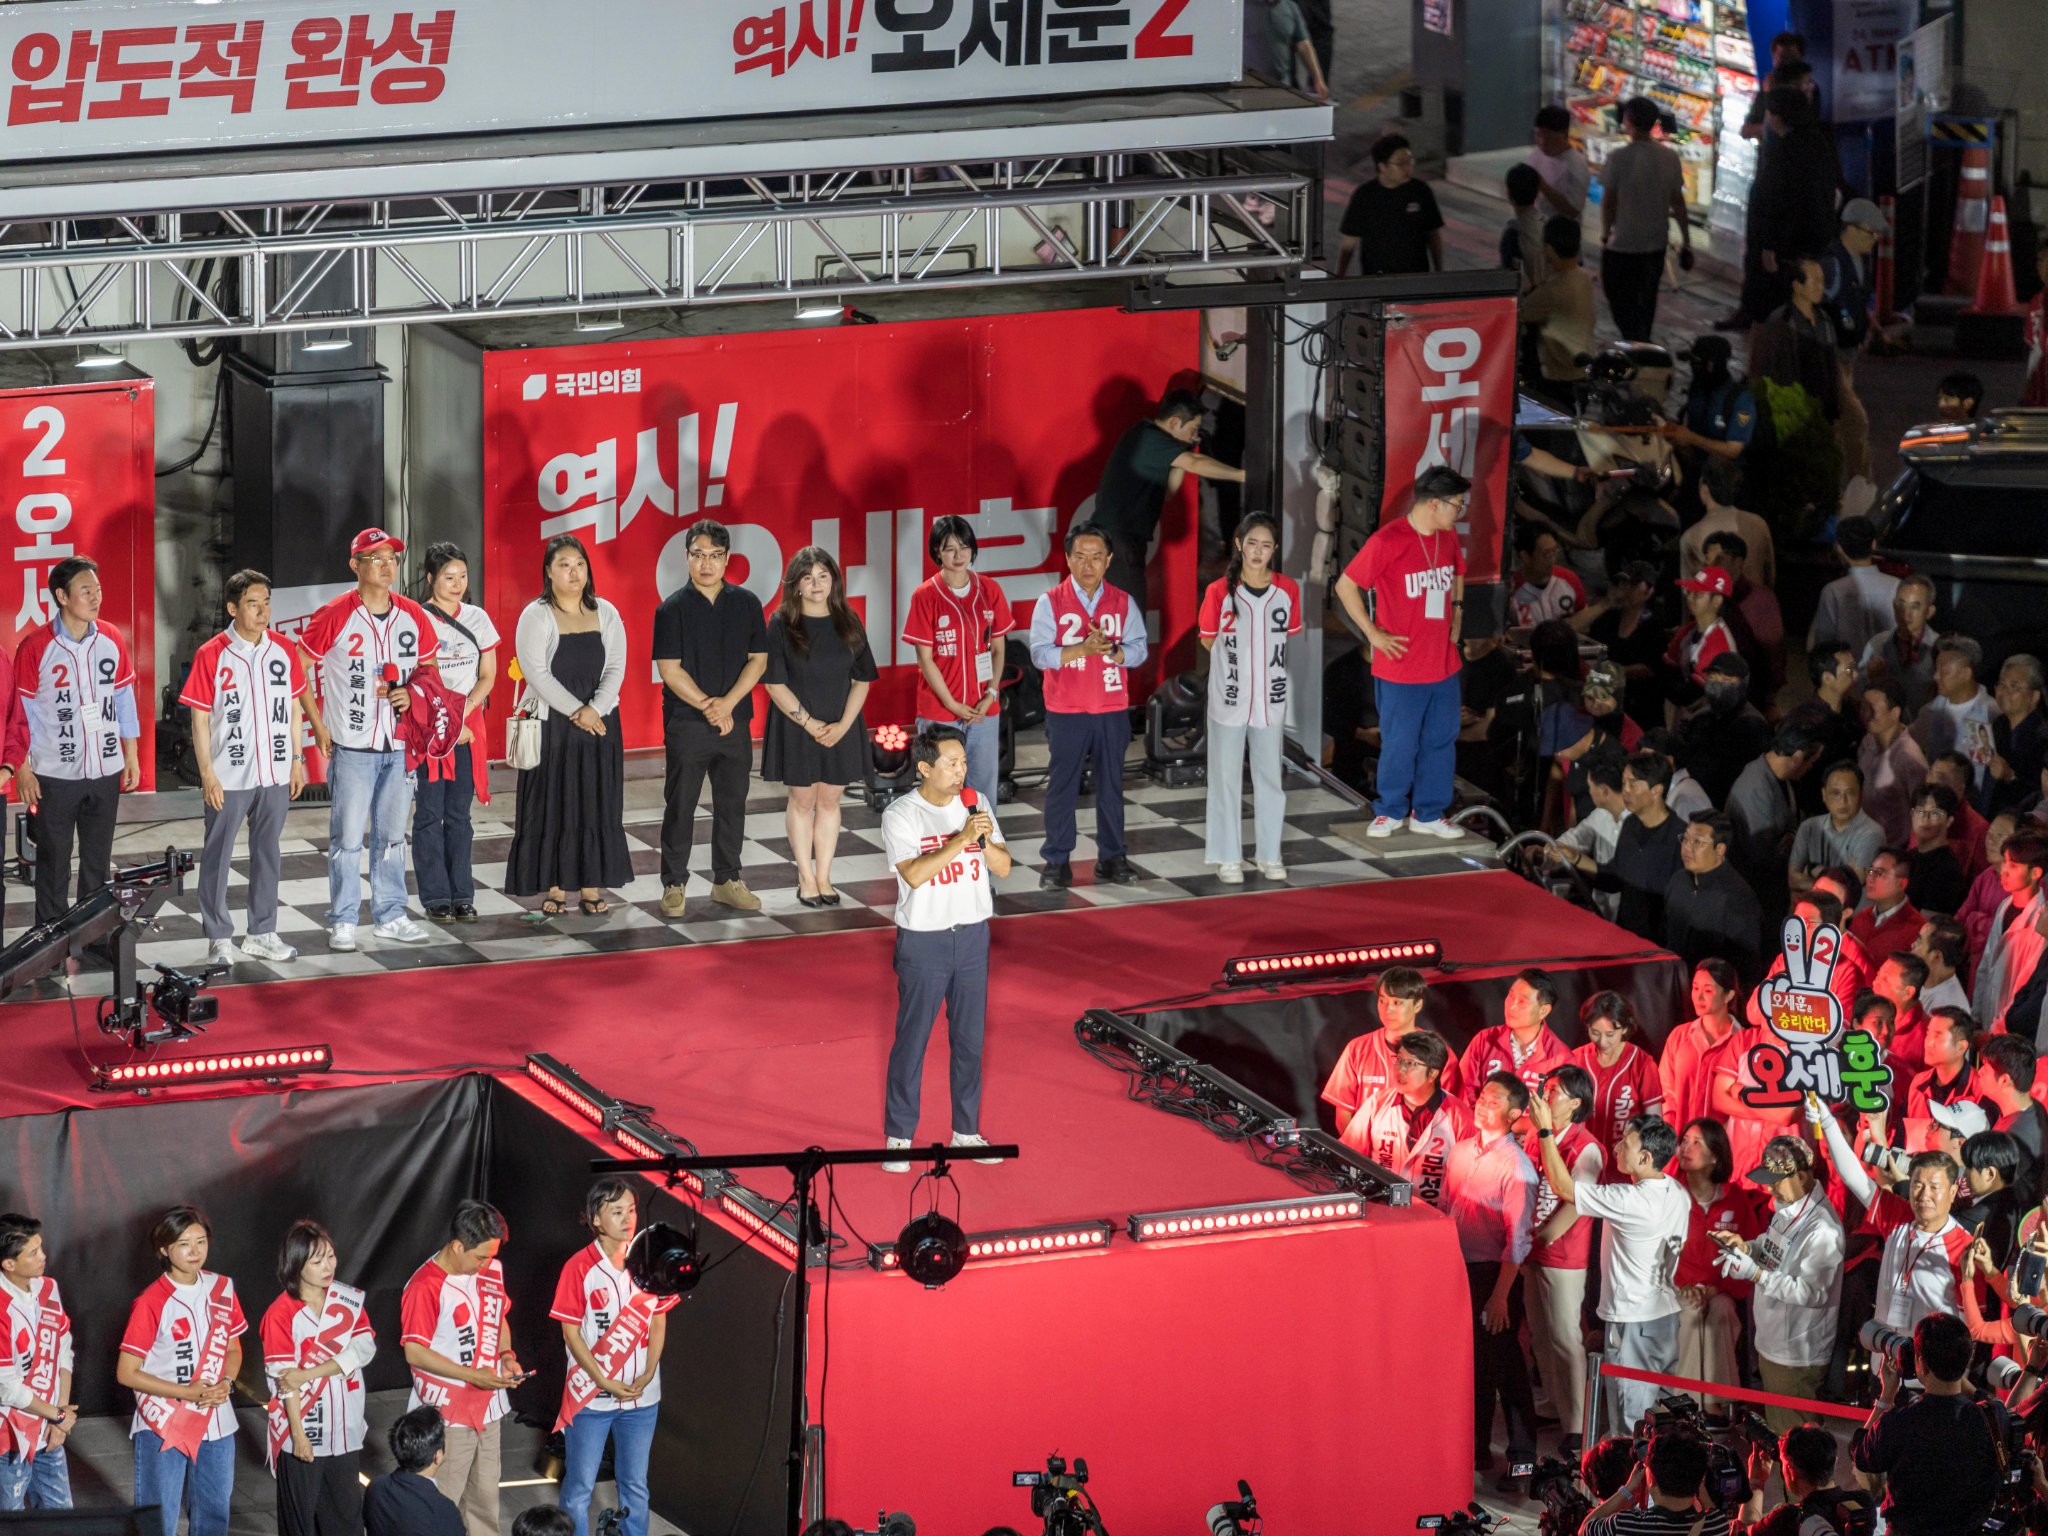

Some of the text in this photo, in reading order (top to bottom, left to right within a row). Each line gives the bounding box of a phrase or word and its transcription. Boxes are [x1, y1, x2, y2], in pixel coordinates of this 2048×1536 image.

[7, 10, 456, 127] 압도적 완성
[555, 367, 642, 397] 국민의힘
[23, 406, 66, 477] 2
[538, 402, 739, 545] 역시!
[348, 633, 364, 657] 2
[1059, 612, 1084, 645] 2
[1222, 611, 1236, 633] 2
[51, 664, 71, 689] 2
[1100, 613, 1123, 692] 이헌
[1225, 635, 1239, 699] 서울시장
[219, 666, 237, 692] 2
[348, 658, 366, 724] 서울시장
[55, 689, 76, 757] 서울시장
[98, 658, 118, 759] 오세훈
[224, 691, 245, 758] 서울시장
[269, 659, 289, 762] 오세훈
[969, 859, 980, 882] 3
[1813, 936, 1834, 966] 2
[1778, 1014, 1830, 1034] 승리한다.
[1621, 1085, 1632, 1099] 2
[1744, 1033, 1891, 1111] 오세훈
[1431, 1137, 1445, 1154] 2
[317, 1302, 355, 1354] 2
